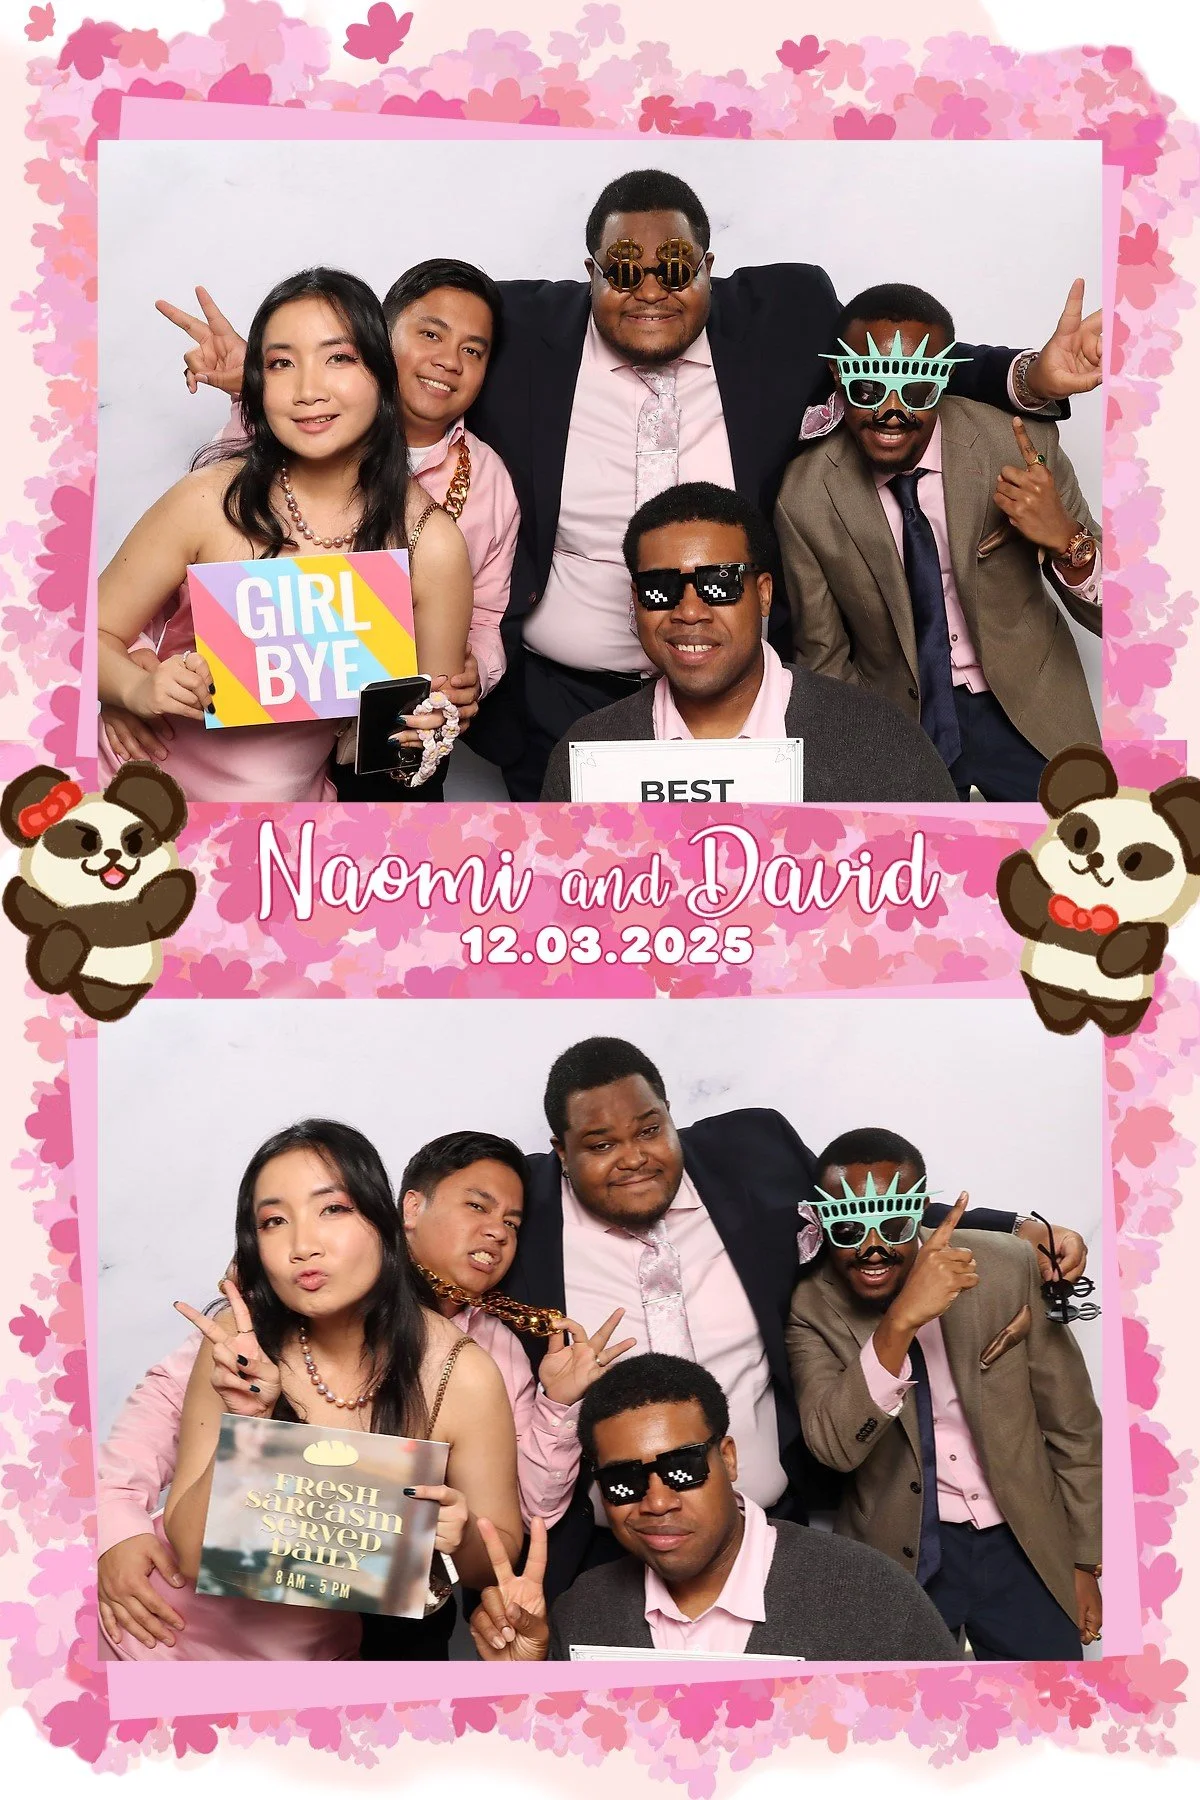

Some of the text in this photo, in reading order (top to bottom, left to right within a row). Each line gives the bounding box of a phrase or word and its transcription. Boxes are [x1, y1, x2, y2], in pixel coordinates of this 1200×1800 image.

[235, 571, 372, 640] GIRL
[255, 639, 361, 706] BYE
[640, 779, 735, 802] BEST
[275, 1570, 283, 1585] 8
[286, 1574, 306, 1590] AM
[319, 1579, 327, 1593] 5
[331, 1582, 351, 1600] PM
